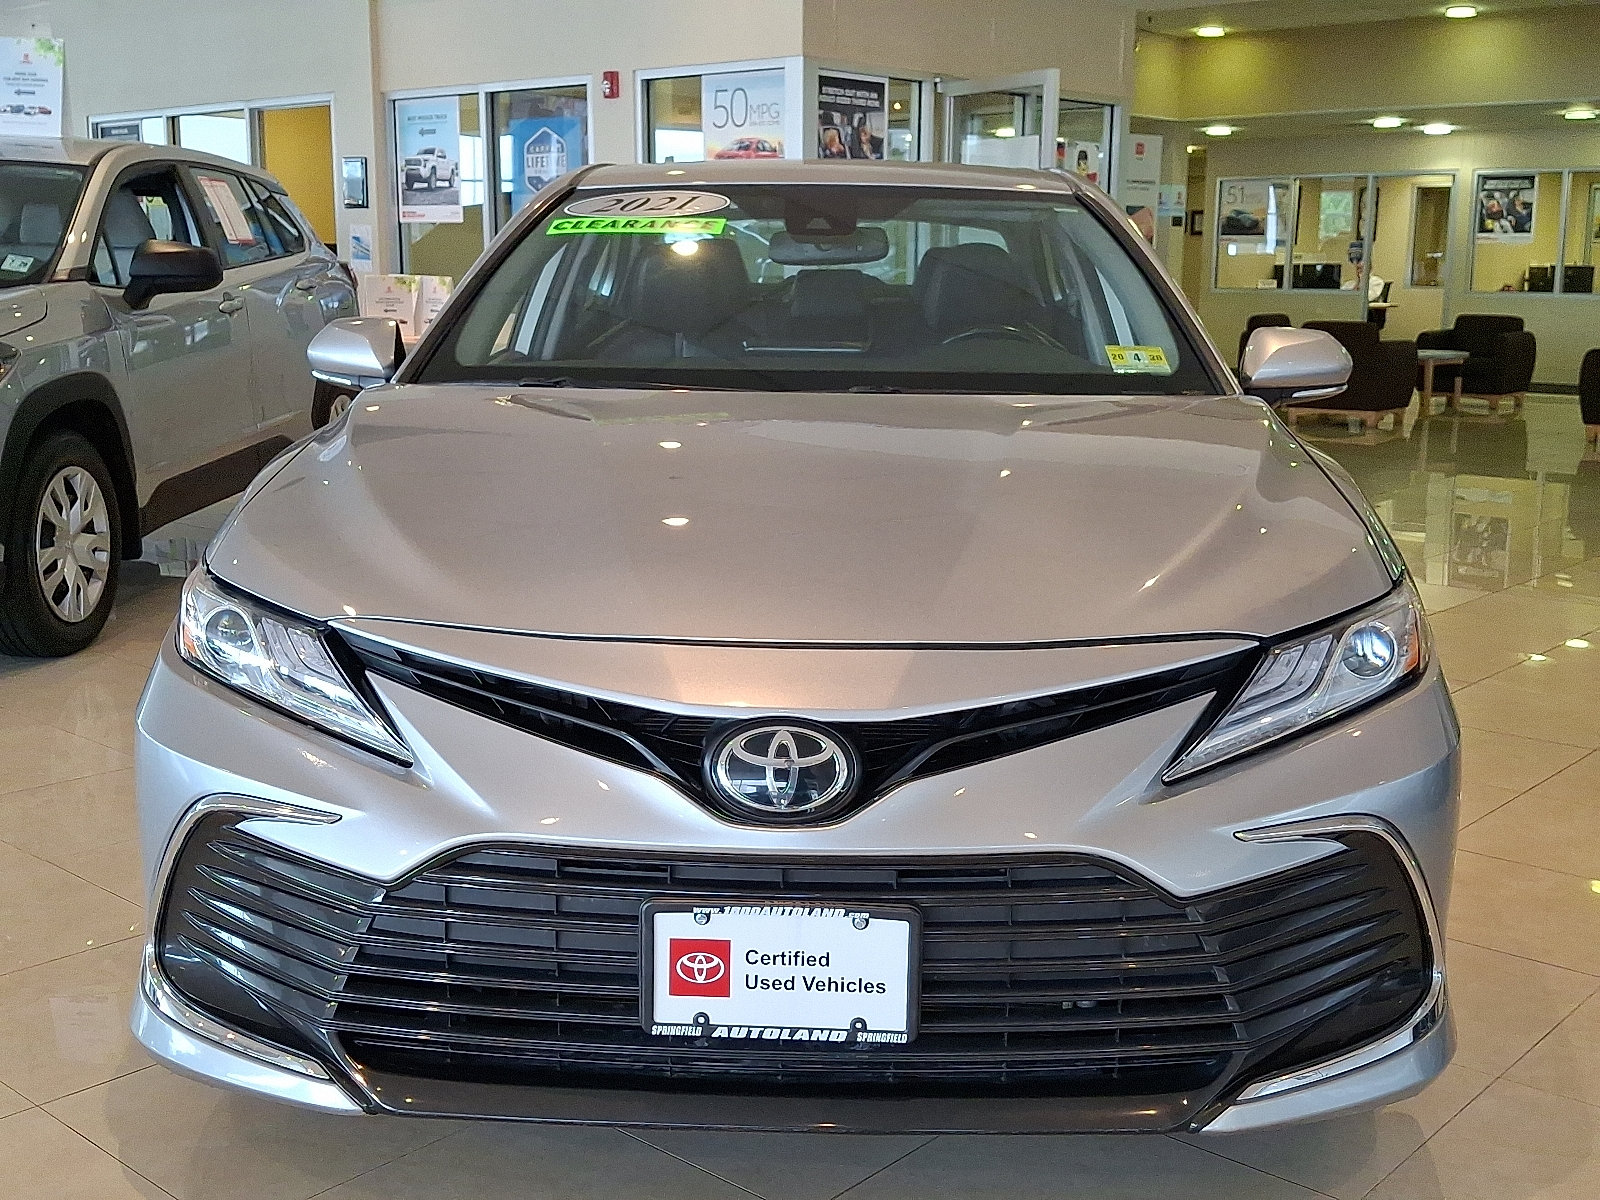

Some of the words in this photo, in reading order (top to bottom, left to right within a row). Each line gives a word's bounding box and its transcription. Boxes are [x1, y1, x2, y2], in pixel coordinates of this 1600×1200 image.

[712, 87, 749, 129] 50
[750, 102, 780, 121] MPG
[526, 154, 568, 169] LIFEE
[590, 195, 702, 214] 2021
[552, 218, 720, 231] CLEARANCE
[1111, 353, 1125, 361] 20
[692, 905, 870, 919] www.1800AUTOLAND.com
[745, 949, 830, 968] Certified
[745, 973, 796, 991] Used
[802, 975, 887, 994] Vehicles
[651, 1024, 703, 1037] SPRINGFIELD
[711, 1025, 849, 1042] AUTOLAND
[856, 1031, 908, 1044] SPRINGFIELD
